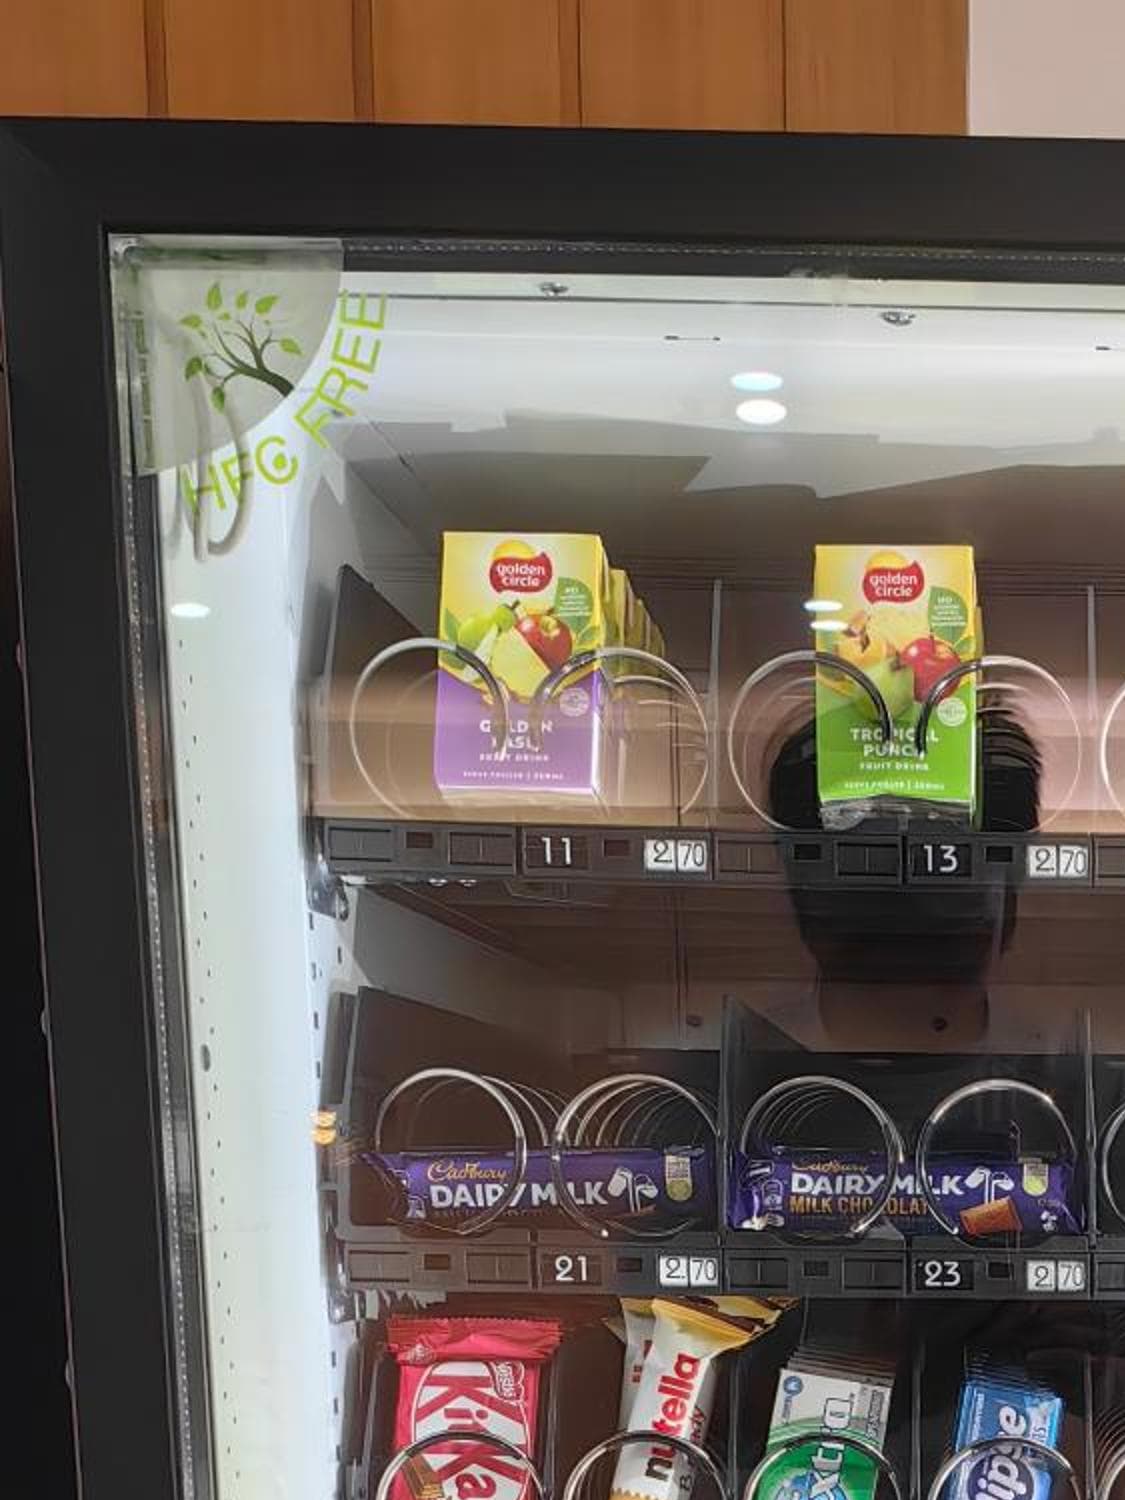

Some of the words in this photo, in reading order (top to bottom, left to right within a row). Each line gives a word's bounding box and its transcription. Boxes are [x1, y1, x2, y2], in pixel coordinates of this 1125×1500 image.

[293, 291, 388, 449] FREE
[496, 560, 545, 577] golden
[501, 574, 540, 587] circle
[869, 572, 918, 588] golden
[874, 584, 913, 598] circle
[541, 837, 572, 866] 11
[923, 844, 958, 873] 13
[427, 1158, 507, 1182] Cadbury
[532, 1182, 608, 1206] MLK
[790, 1174, 885, 1195] DAIRY
[788, 1196, 832, 1215] MILK
[838, 1197, 930, 1216] CHOOLAT
[554, 1255, 588, 1282] 21
[924, 1260, 961, 1287] 23
